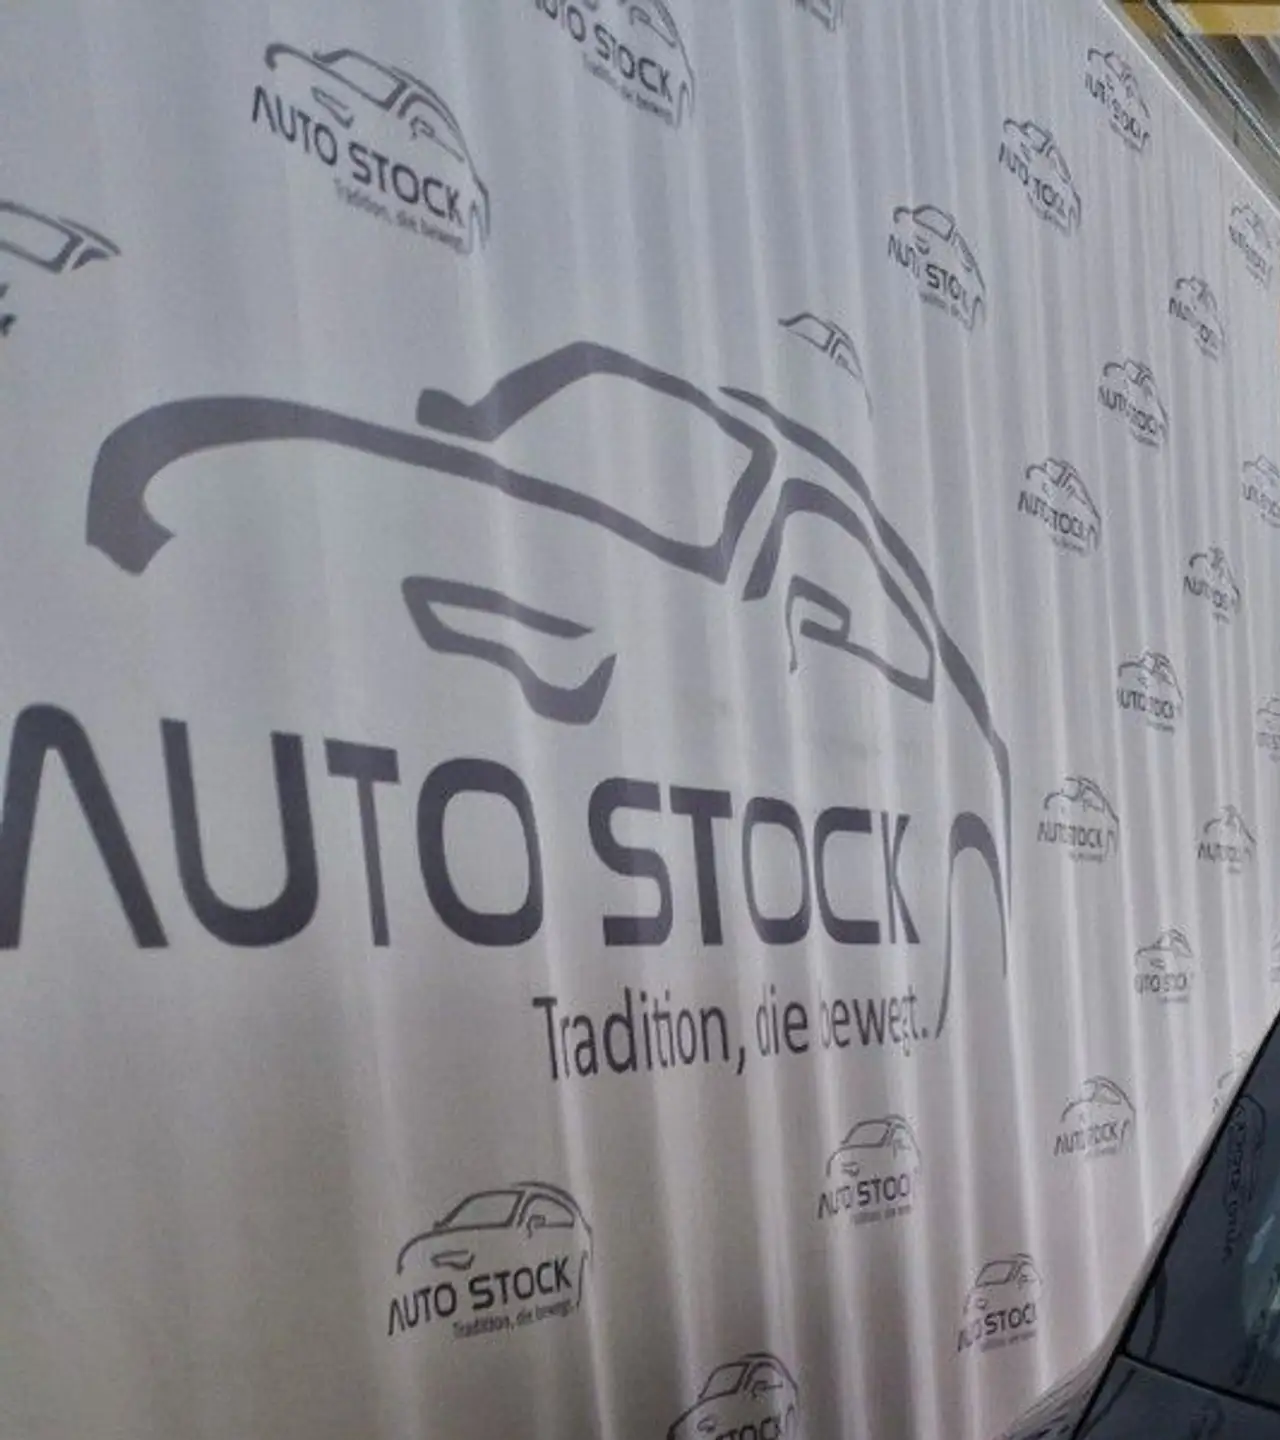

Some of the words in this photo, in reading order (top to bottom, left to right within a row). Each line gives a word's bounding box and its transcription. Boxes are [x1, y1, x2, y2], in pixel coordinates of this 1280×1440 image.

[594, 24, 673, 102] STOCK
[252, 84, 338, 167] AUTO
[348, 141, 465, 229] STOCK
[0, 703, 544, 949] AUTO
[587, 775, 922, 947] STOCK
[532, 985, 747, 1081] Tradition,
[755, 983, 809, 1057] die
[856, 1172, 911, 1208] STOC
[387, 1282, 458, 1338] AUTO
[467, 1256, 573, 1311] STOCK
[984, 1301, 1036, 1336] STOC
